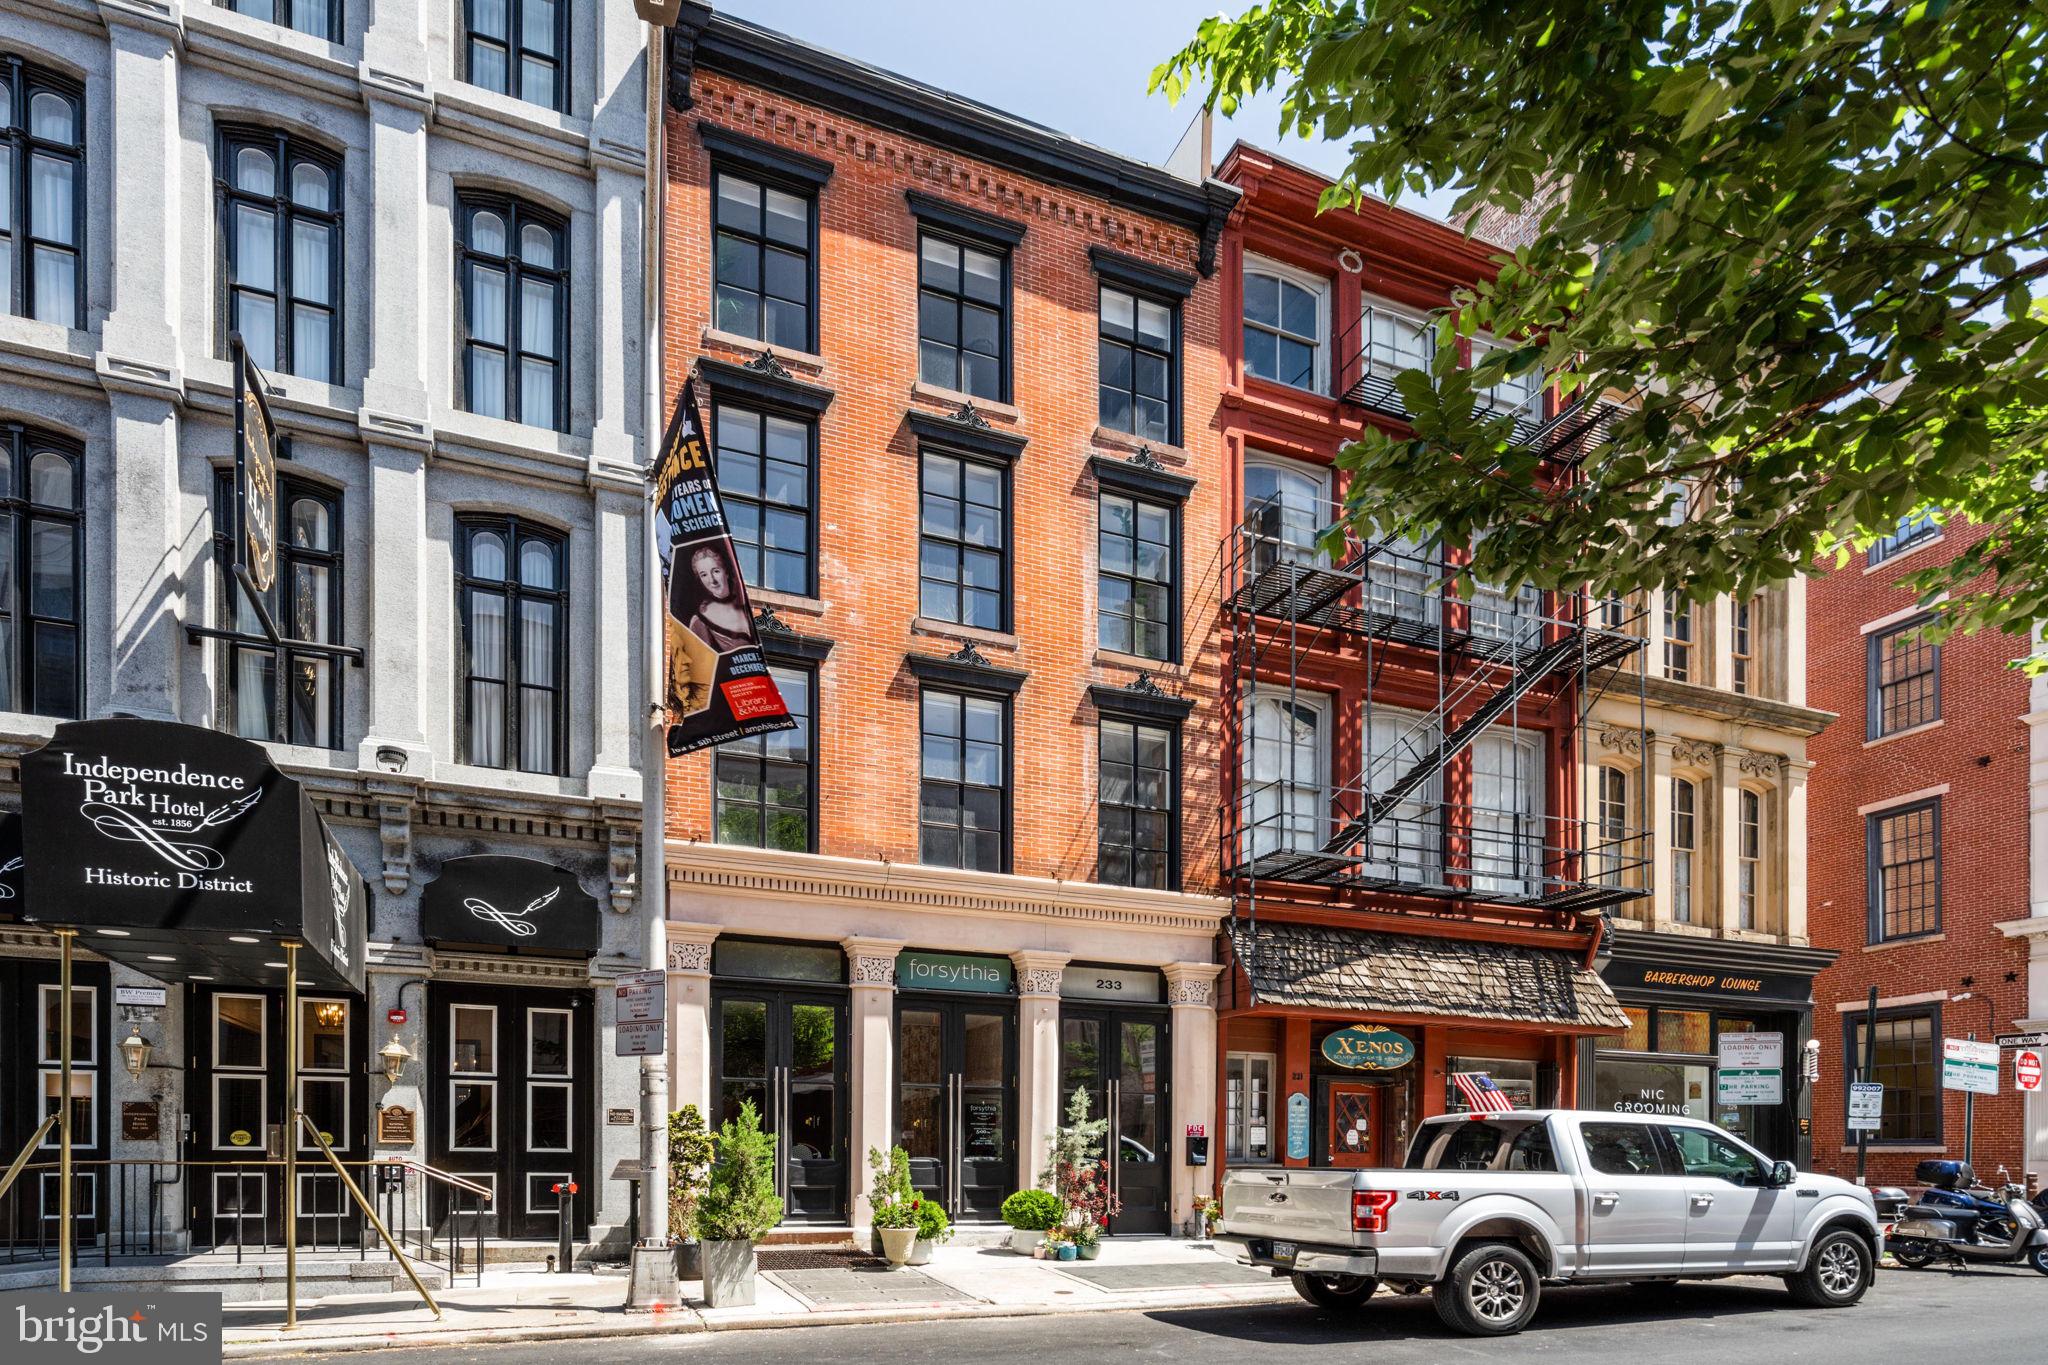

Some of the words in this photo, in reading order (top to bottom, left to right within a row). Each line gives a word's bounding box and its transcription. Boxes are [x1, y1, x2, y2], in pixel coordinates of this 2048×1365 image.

[674, 479, 702, 497] YEARS
[682, 513, 724, 533] SCIENCE
[731, 653, 755, 664] MARCH
[734, 696, 767, 709] Library
[712, 730, 739, 743] Street
[63, 752, 244, 790] Independence
[84, 778, 146, 807] Park
[150, 793, 205, 817] Hotel
[152, 818, 169, 827] est.
[171, 818, 192, 828] 1856
[85, 867, 171, 888] Historic
[177, 872, 253, 893] District
[909, 959, 1001, 983] forsythia
[1096, 979, 1122, 991] 233
[1644, 971, 1716, 988] BARBERSHOP
[1720, 977, 1762, 992] LOUNGE
[628, 987, 652, 997] PARKING
[618, 1025, 643, 1034] LOADING
[645, 1023, 661, 1032] ONLY
[1336, 1037, 1404, 1055] XENOS
[1641, 1088, 1665, 1100] NIC
[1614, 1102, 1690, 1115] GROOMING
